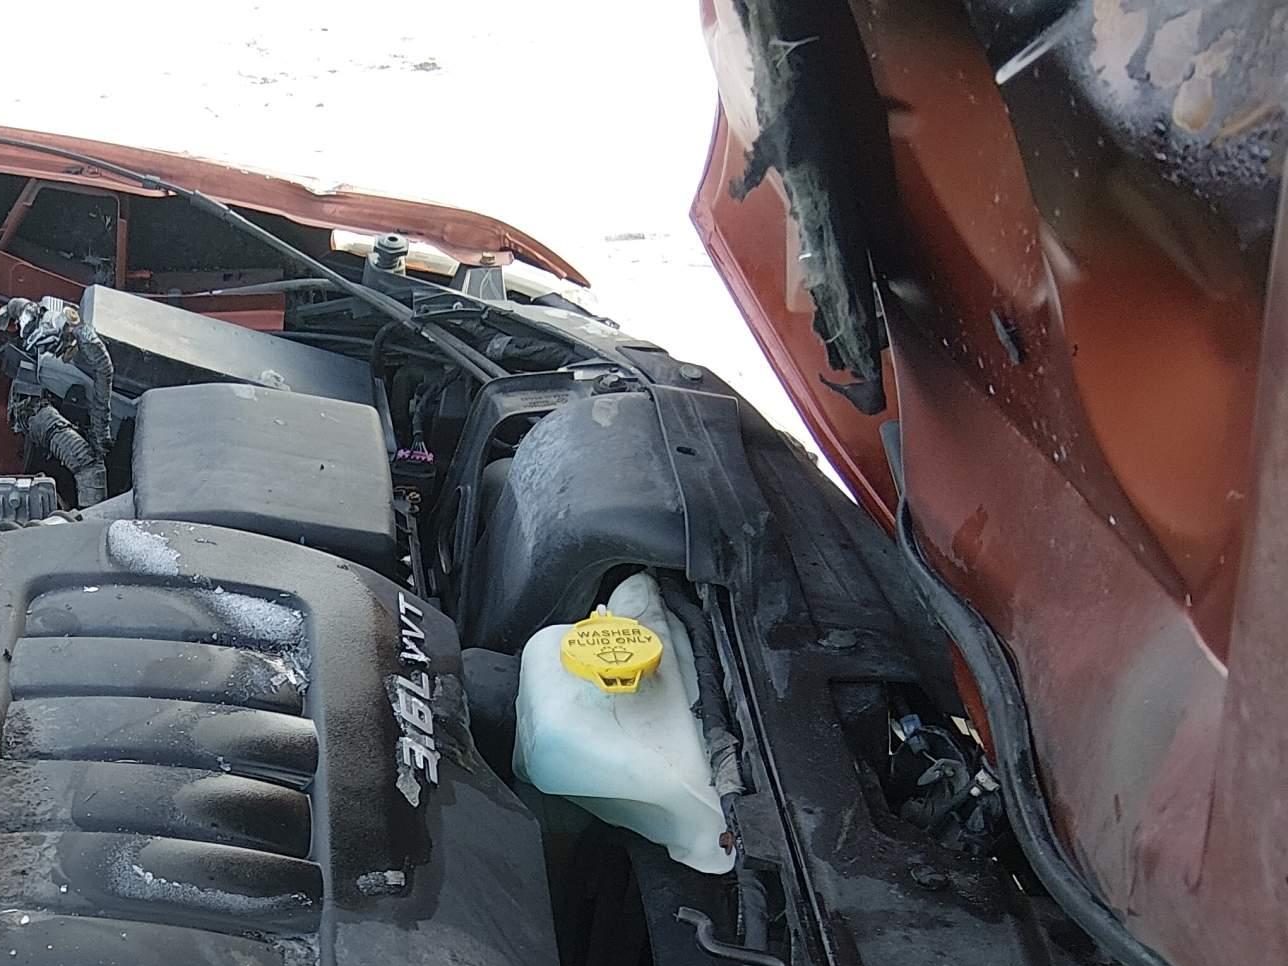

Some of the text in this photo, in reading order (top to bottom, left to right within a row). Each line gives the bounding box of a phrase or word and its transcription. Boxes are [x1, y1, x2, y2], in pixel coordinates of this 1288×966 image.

[576, 628, 642, 639] WASHER
[567, 635, 653, 647] FLUID ONLY
[396, 591, 439, 784] 3.6L VVT
